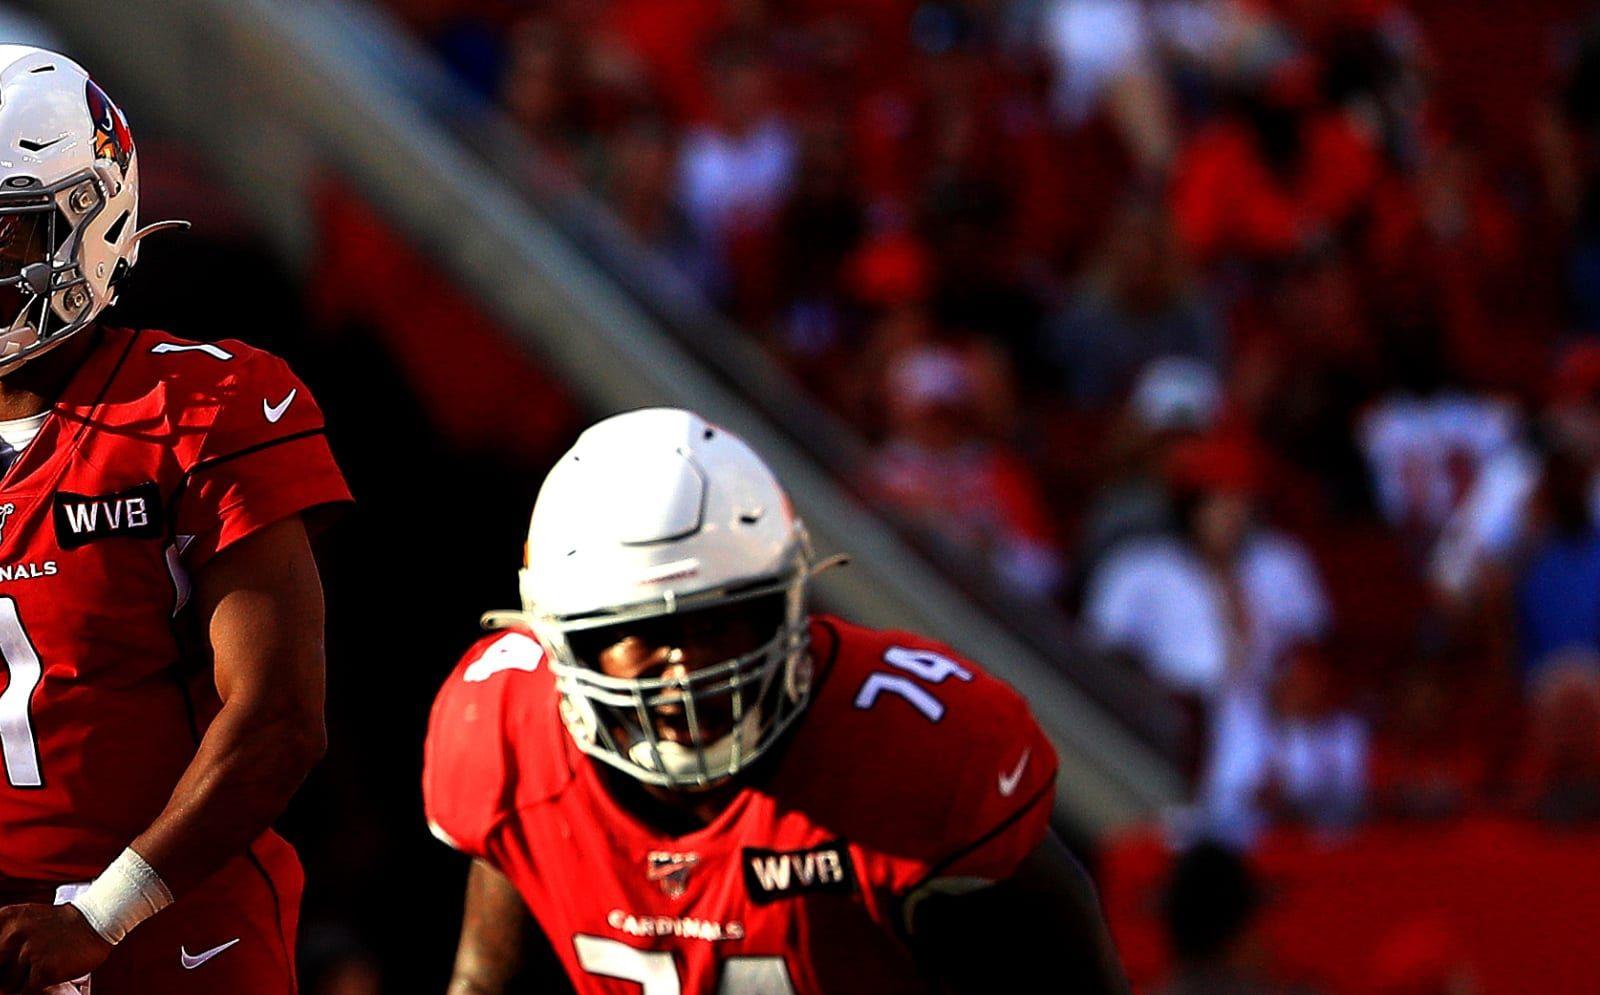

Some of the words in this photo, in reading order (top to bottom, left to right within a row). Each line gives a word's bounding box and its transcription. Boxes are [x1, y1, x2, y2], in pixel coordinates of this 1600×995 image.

[64, 497, 149, 534] WVB
[854, 646, 974, 723] 74
[607, 909, 744, 941] CARDINALS
